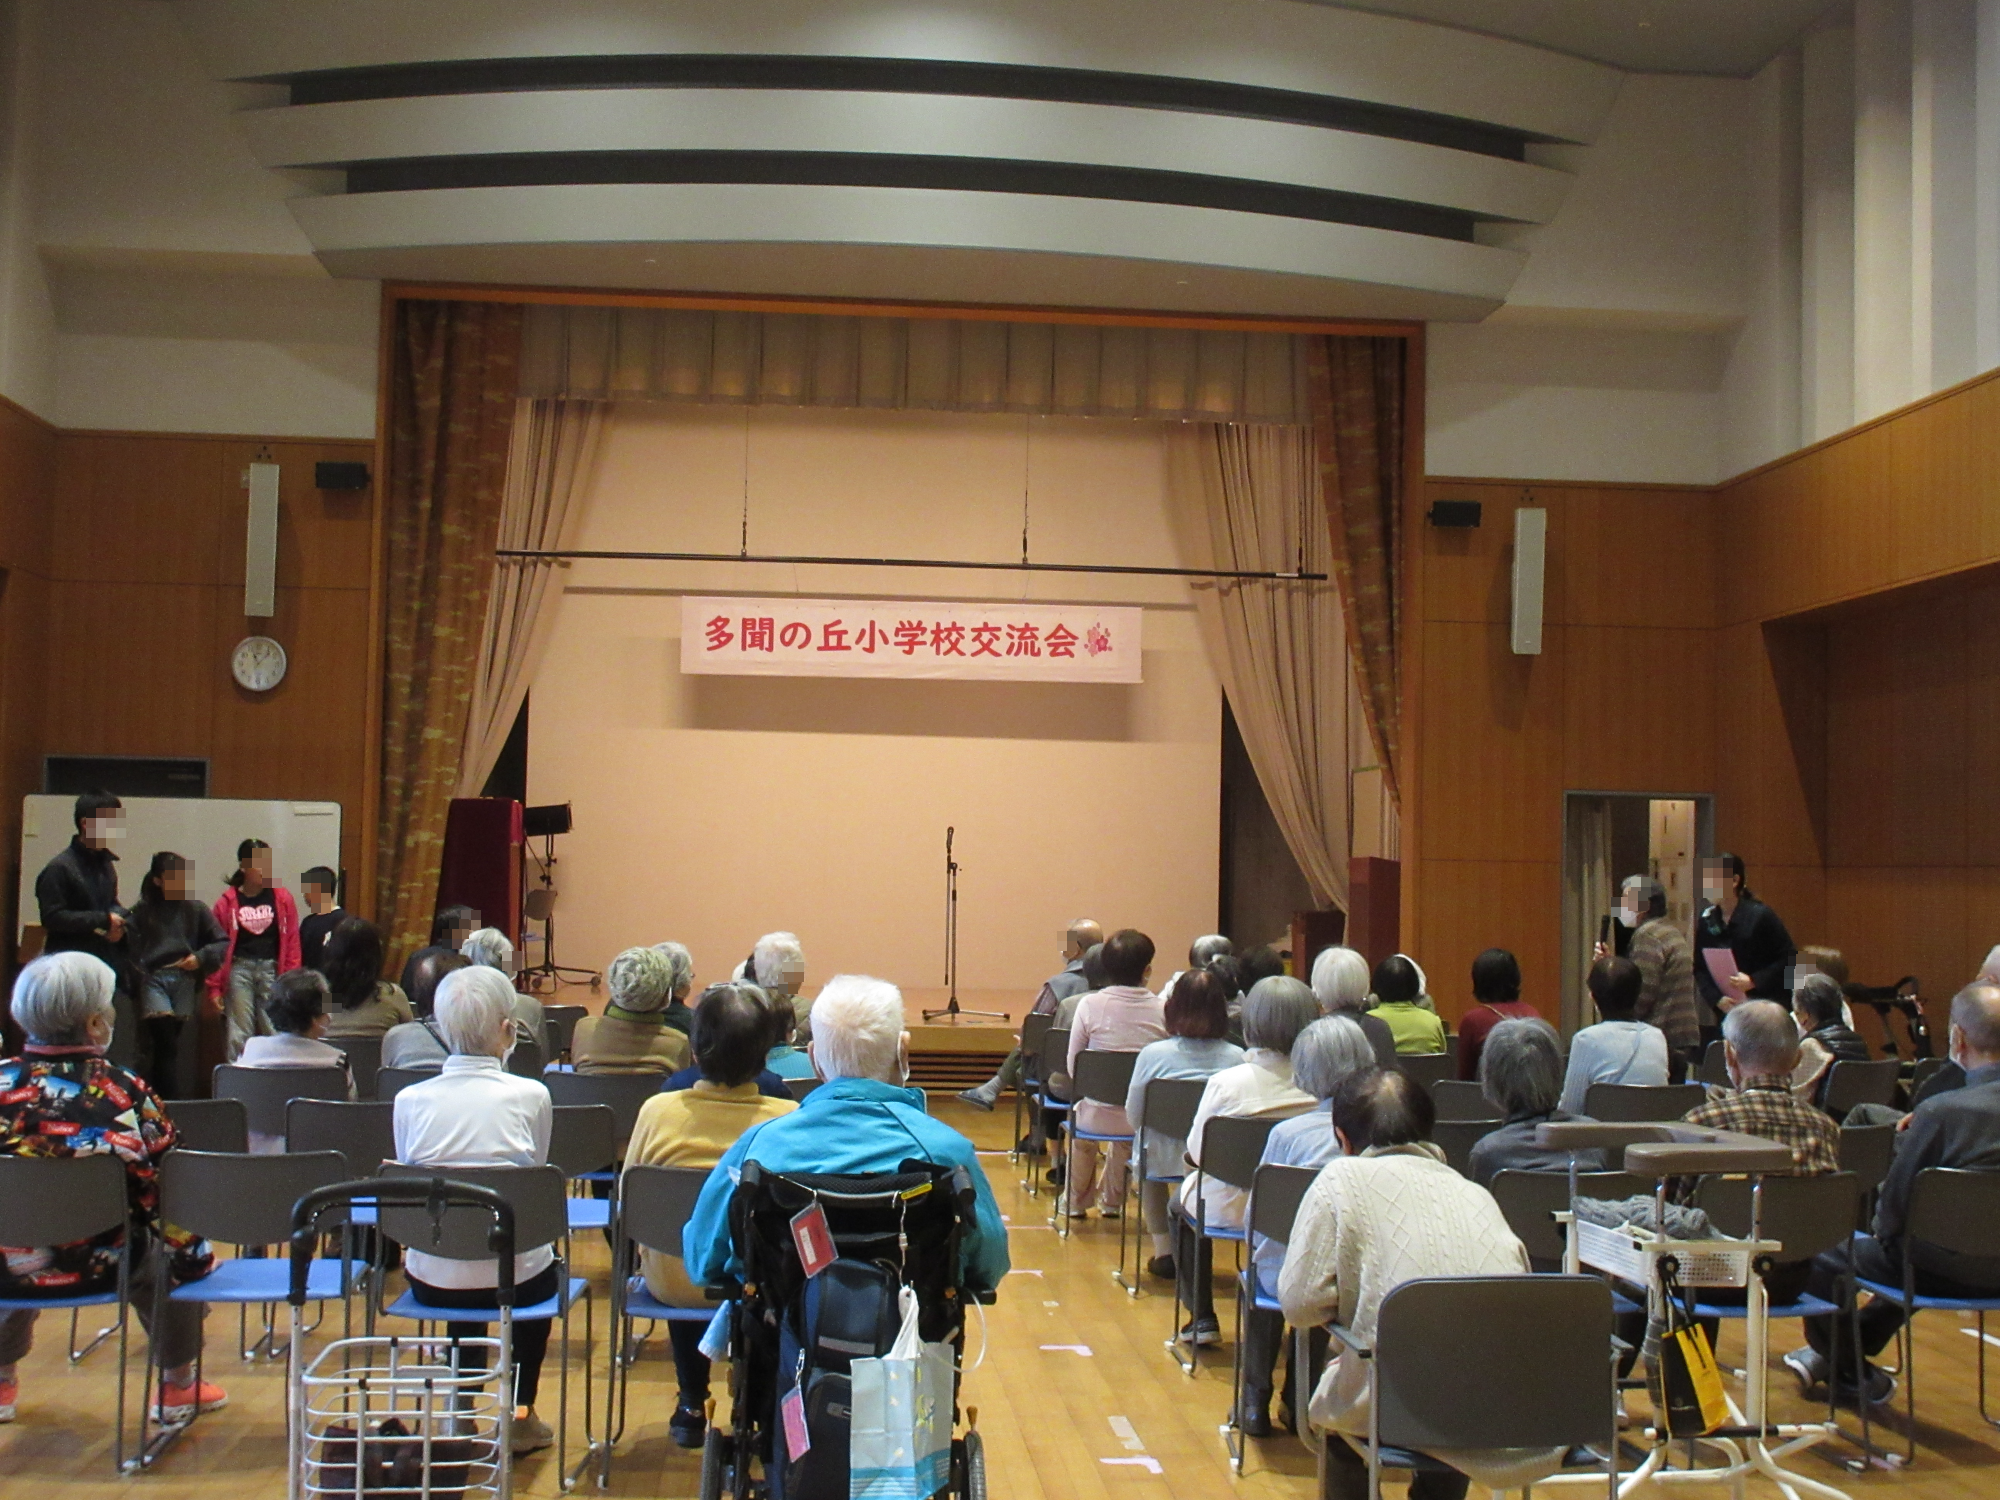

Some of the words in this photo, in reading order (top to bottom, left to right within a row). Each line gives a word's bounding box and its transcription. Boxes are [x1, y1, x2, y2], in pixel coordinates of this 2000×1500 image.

[705, 615, 1079, 658] 多聞の丘小学校交流会
